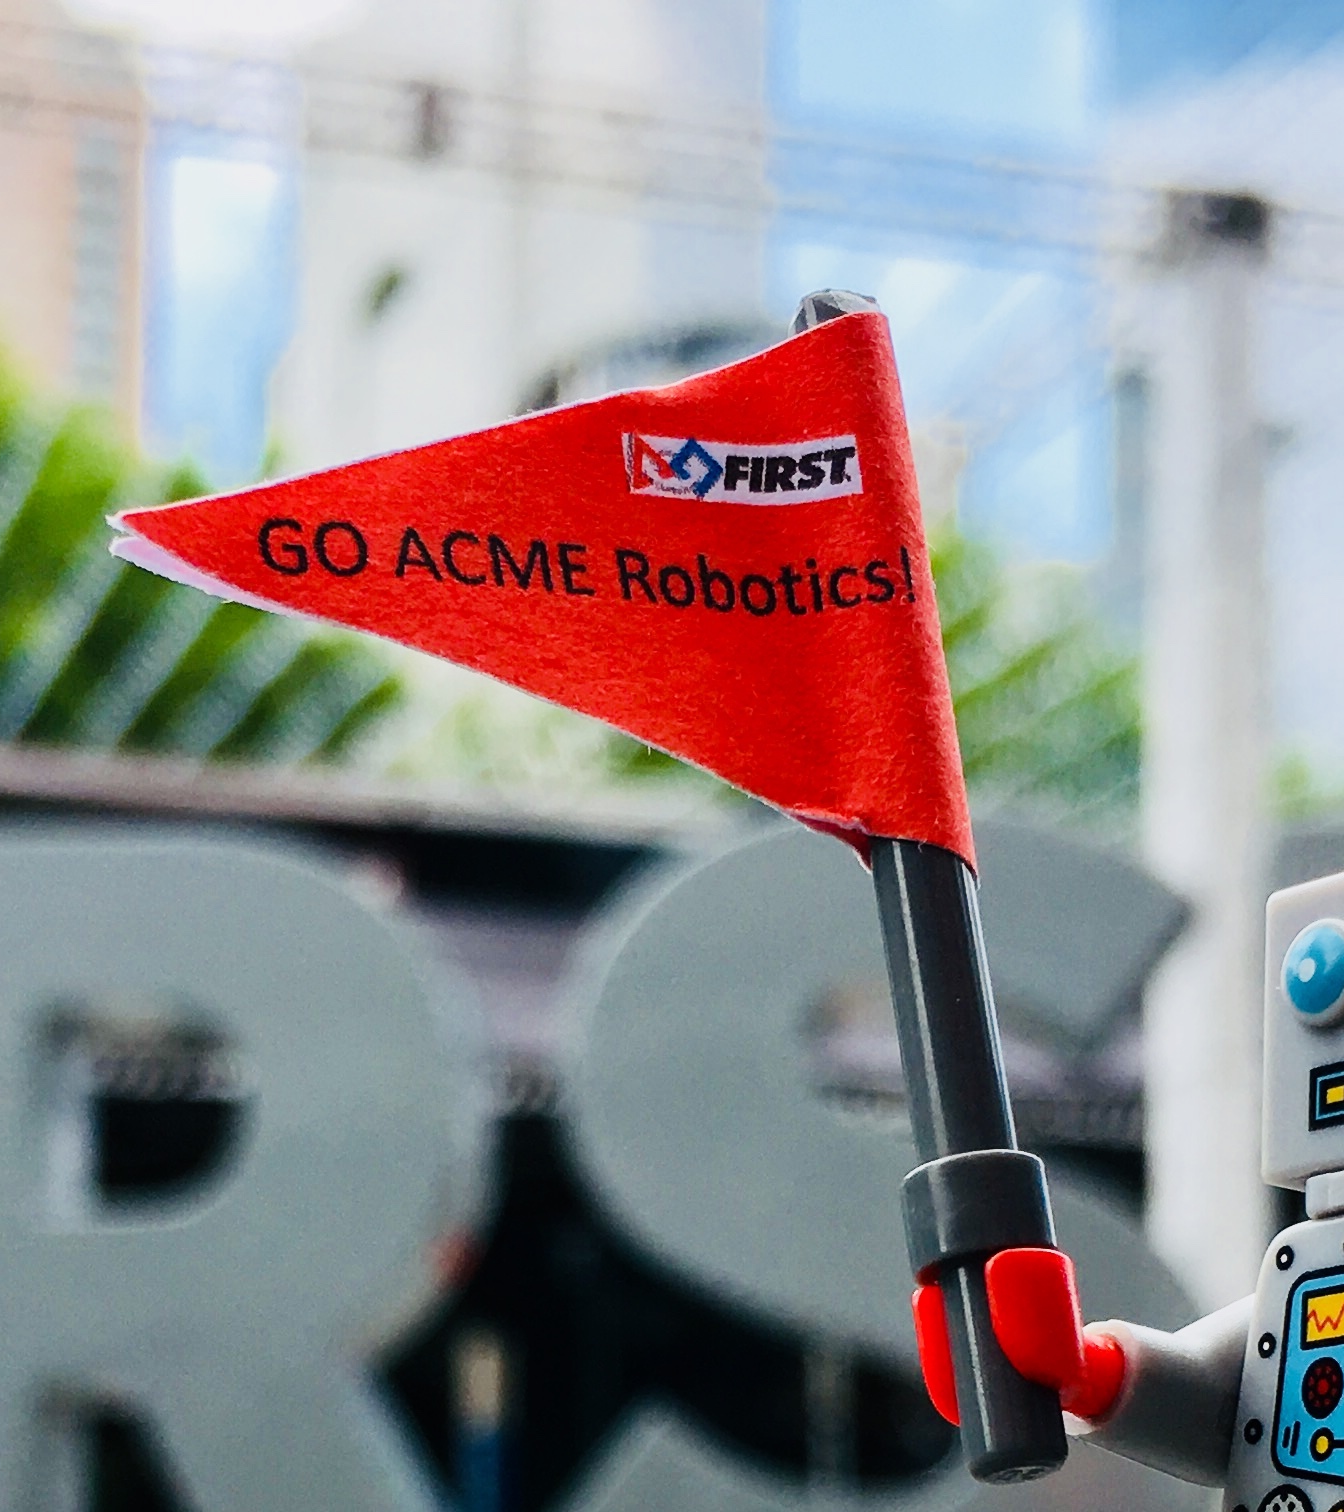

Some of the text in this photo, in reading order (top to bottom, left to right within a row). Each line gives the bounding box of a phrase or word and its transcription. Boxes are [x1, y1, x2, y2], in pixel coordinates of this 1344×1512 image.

[258, 517, 916, 617] GO ACME Robotics!
